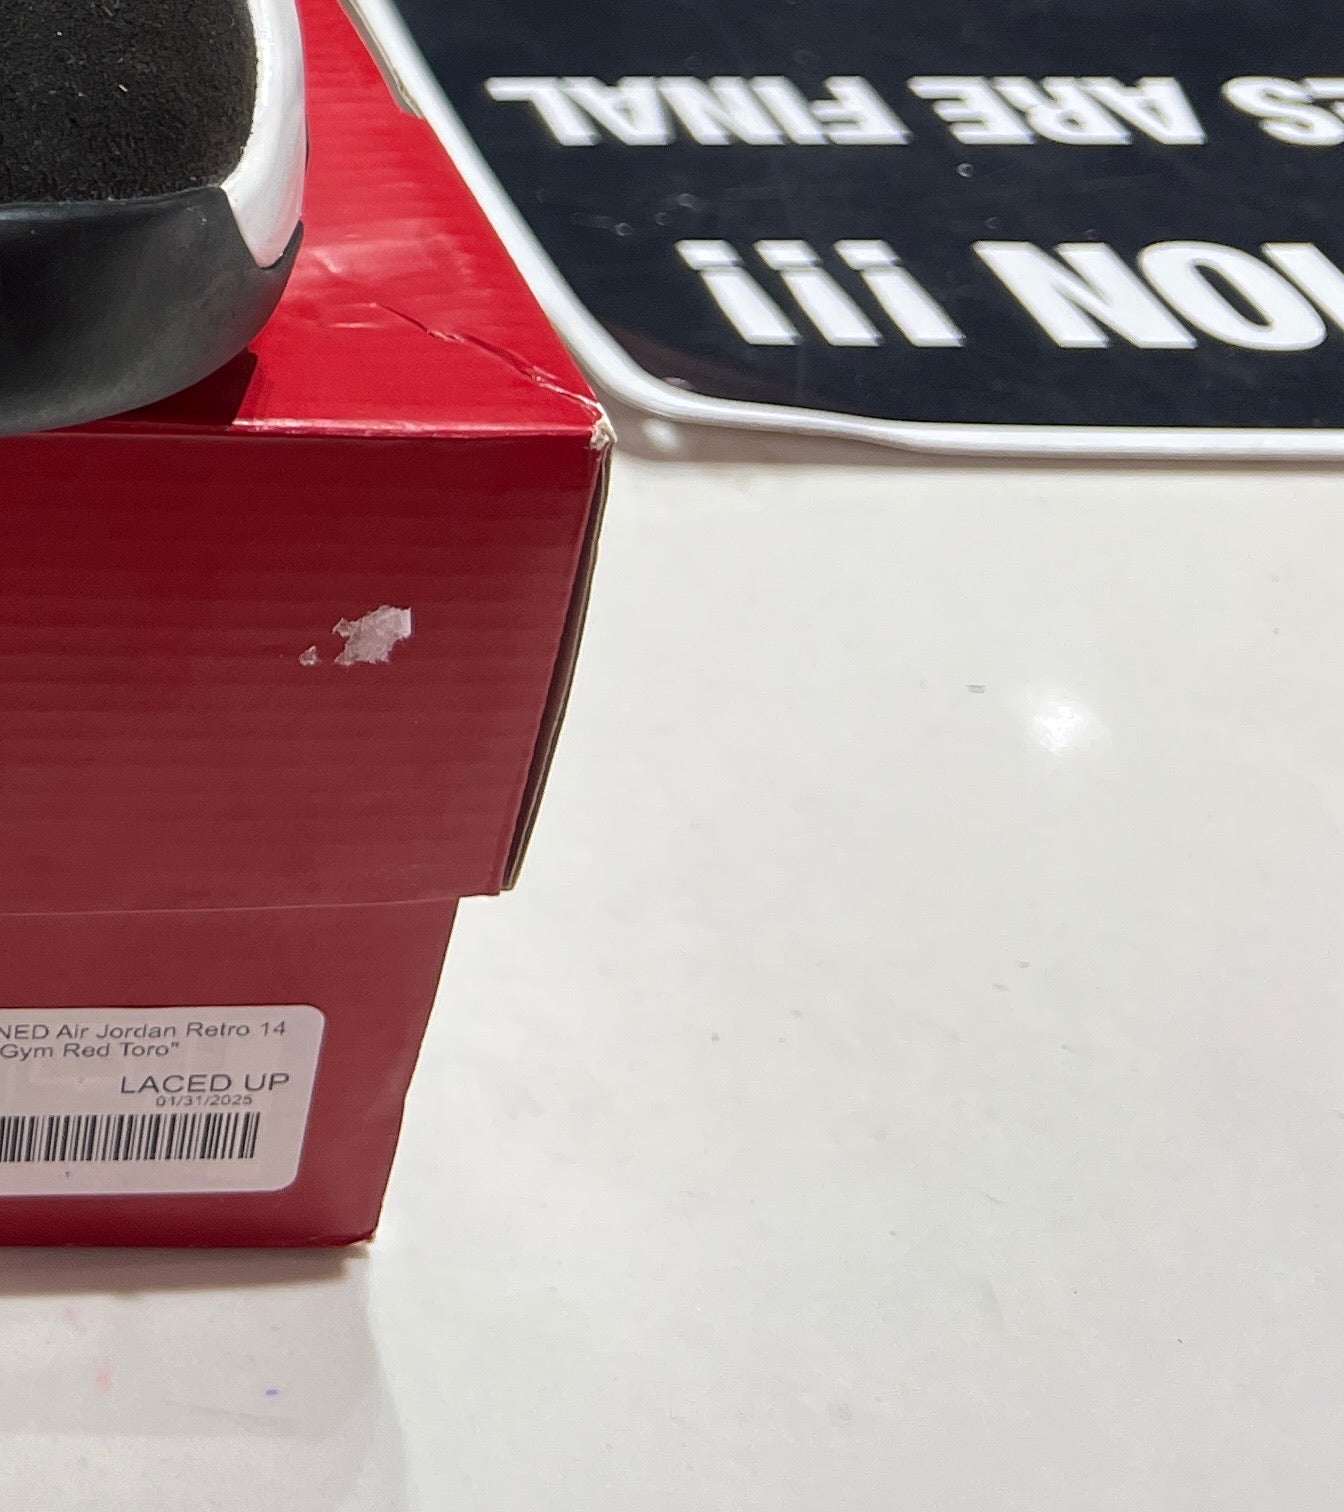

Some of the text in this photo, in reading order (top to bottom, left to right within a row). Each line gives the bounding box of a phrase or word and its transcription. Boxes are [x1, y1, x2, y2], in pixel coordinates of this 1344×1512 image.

[485, 76, 913, 146] FINAL
[910, 76, 1208, 146] ARE
[57, 1024, 89, 1039] Air
[96, 1023, 176, 1039] Jordan
[186, 1021, 250, 1038] Retro
[261, 1021, 286, 1037] 14
[63, 1042, 110, 1058] Red
[119, 1041, 180, 1057] Toro"
[120, 1072, 290, 1094] LACED UP
[156, 1094, 253, 1107] 01/31/2025
